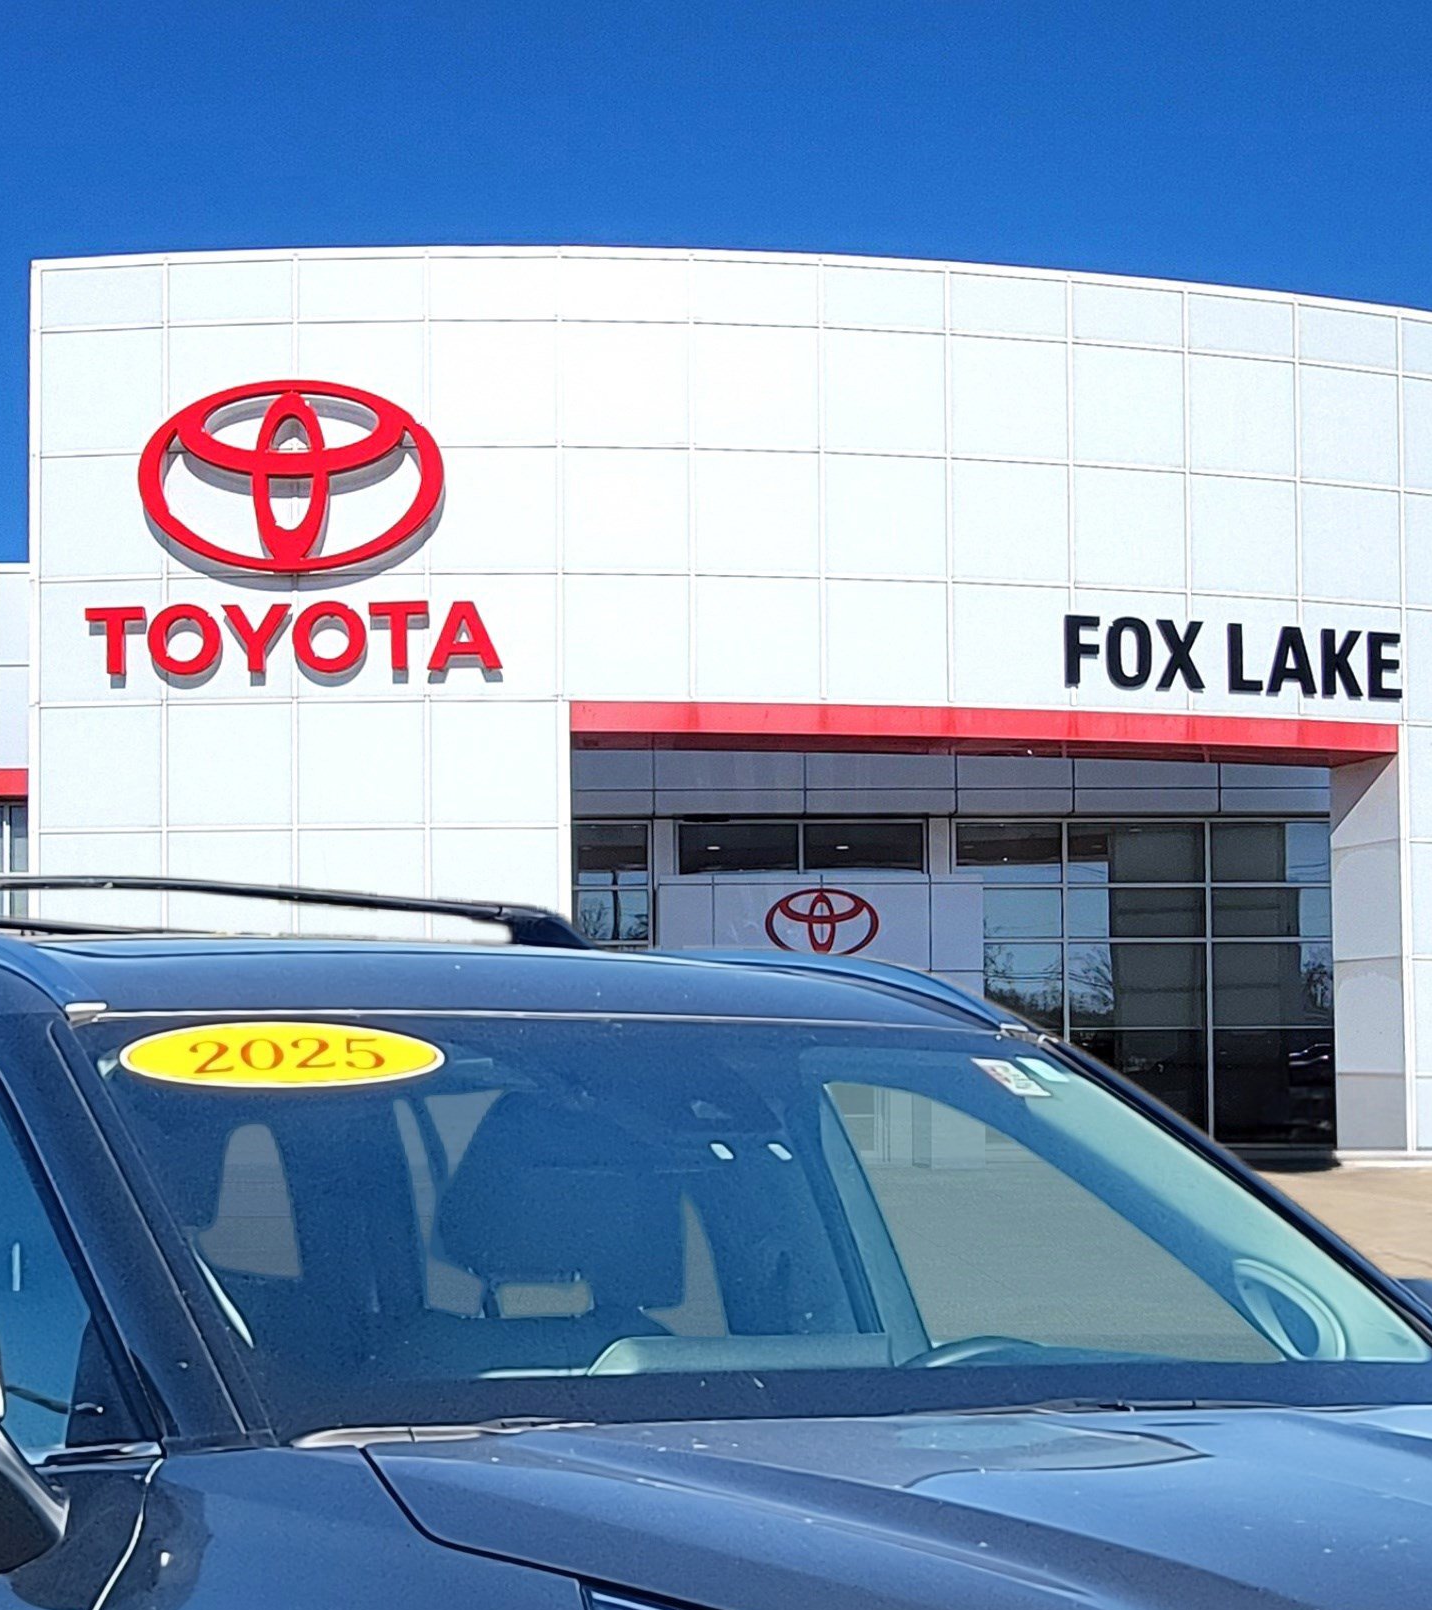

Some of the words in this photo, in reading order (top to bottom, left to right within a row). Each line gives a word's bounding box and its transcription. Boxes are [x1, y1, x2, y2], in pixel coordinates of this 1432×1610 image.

[84, 600, 504, 678] TOYOTA
[1064, 614, 1206, 692] FOX
[1227, 623, 1403, 701] LAKE
[188, 1037, 386, 1075] 2025
